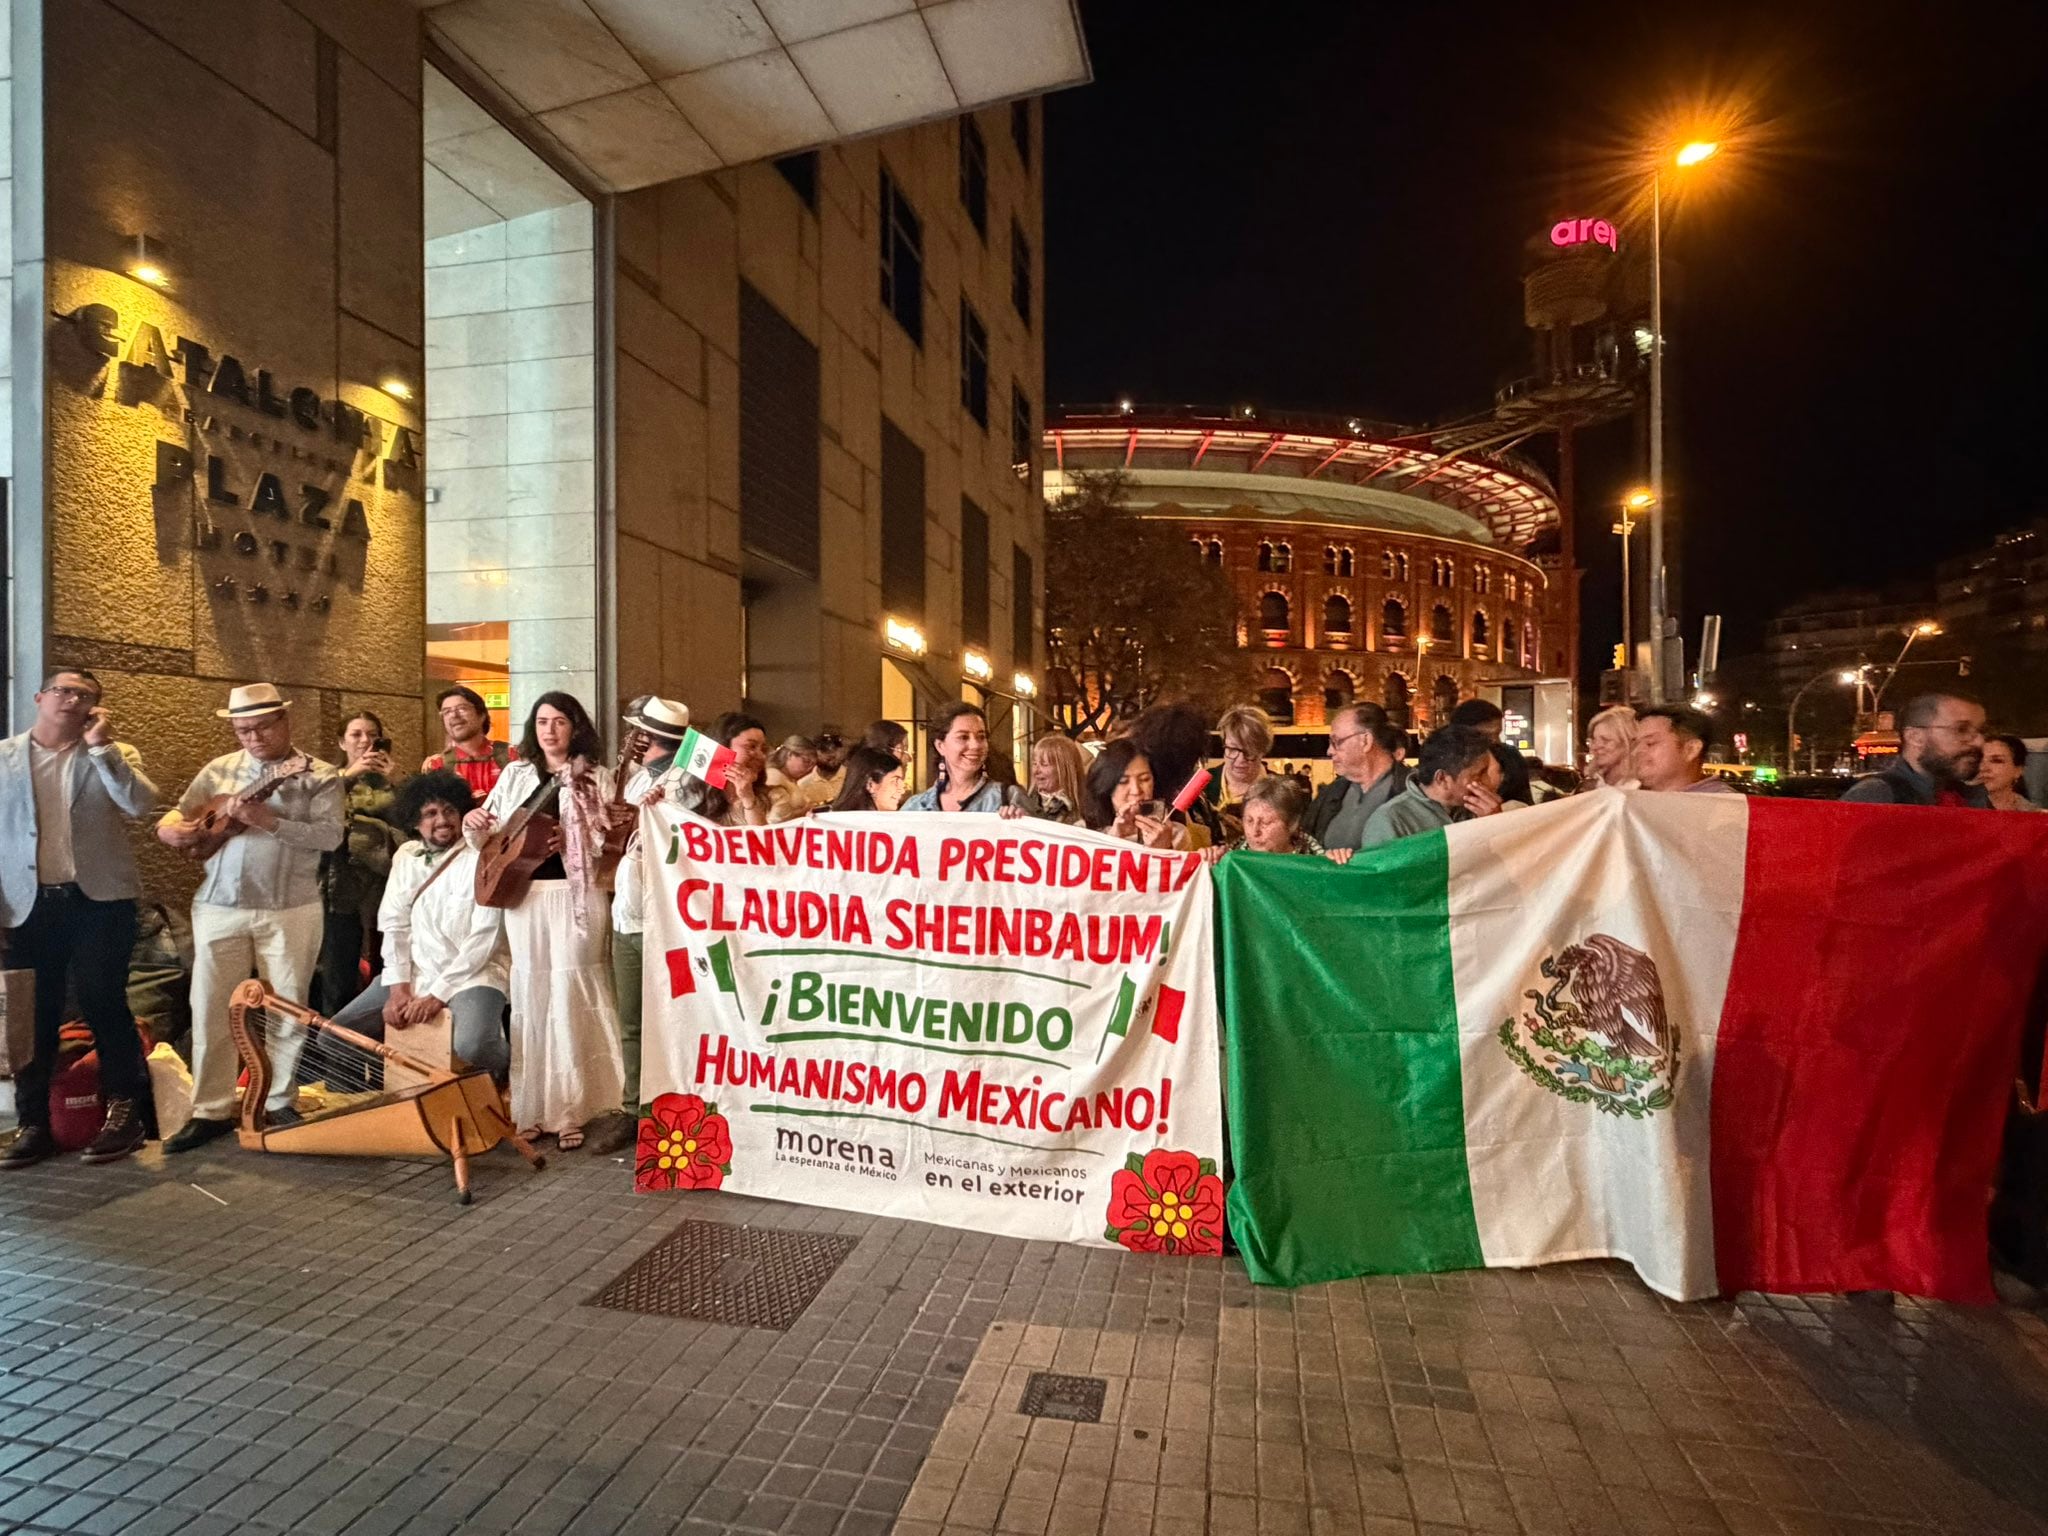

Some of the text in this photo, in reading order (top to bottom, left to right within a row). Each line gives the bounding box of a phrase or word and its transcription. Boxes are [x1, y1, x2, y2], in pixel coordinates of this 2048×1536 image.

[156, 439, 371, 541] PLAZA
[197, 520, 340, 578] HOTEL
[665, 821, 920, 879] ¡BIENVENIDA
[676, 878, 1171, 967] CLAUDIA SHEINBAUM!
[760, 970, 1074, 1052] ¡BIENVENIDO
[694, 1033, 1172, 1135] HUMANISMO MEXICANO!
[775, 1152, 898, 1182] La esperanza de México
[776, 1127, 896, 1169] morena
[924, 1151, 1087, 1180] Mexicanas y Mexicanos
[925, 1170, 1086, 1205] en el exterior
